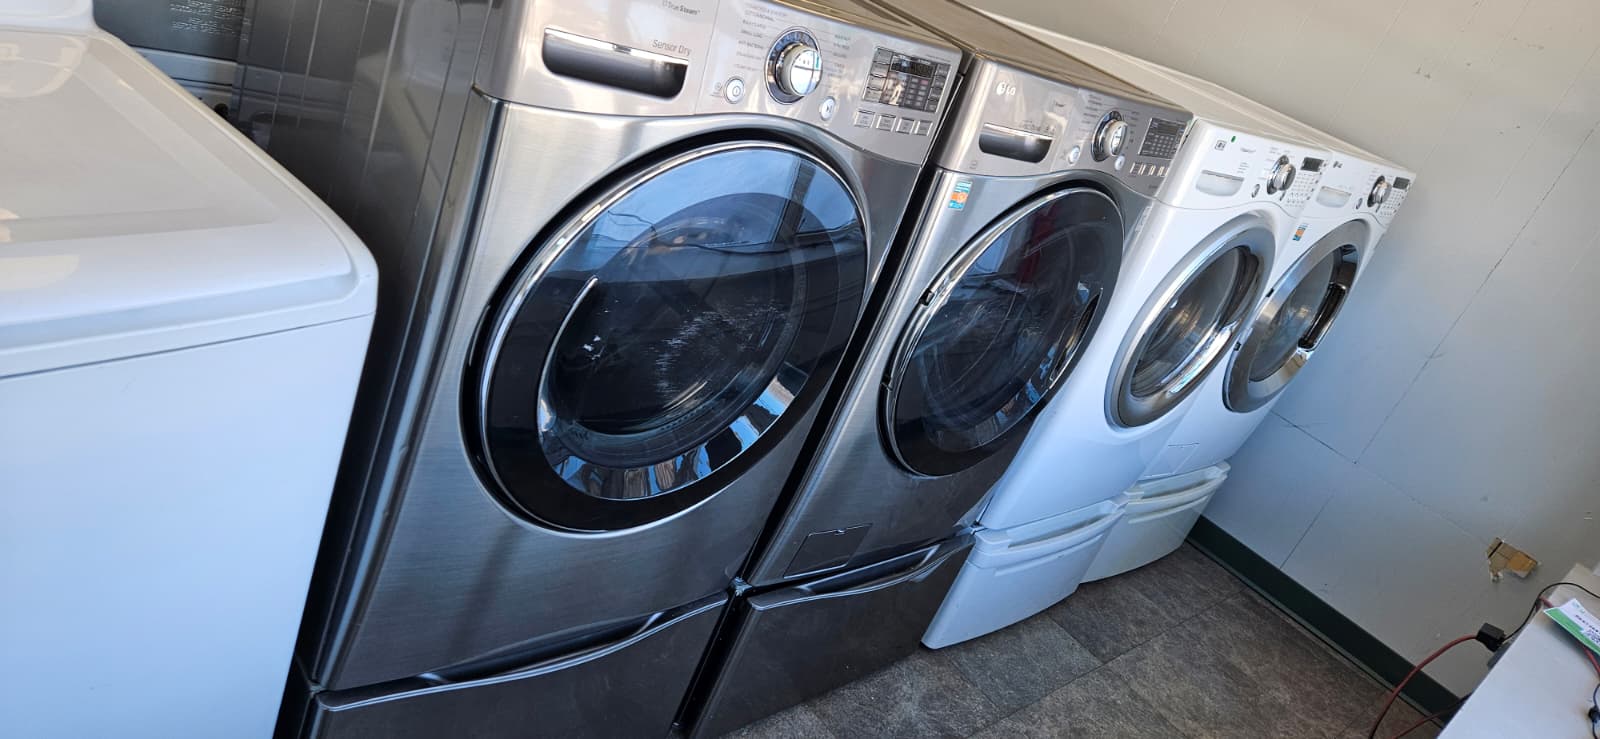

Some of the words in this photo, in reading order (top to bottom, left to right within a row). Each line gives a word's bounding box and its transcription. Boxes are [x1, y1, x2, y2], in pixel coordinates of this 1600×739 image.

[652, 39, 677, 52] Sensor
[679, 45, 692, 56] Dry
[1006, 85, 1016, 96] LG
